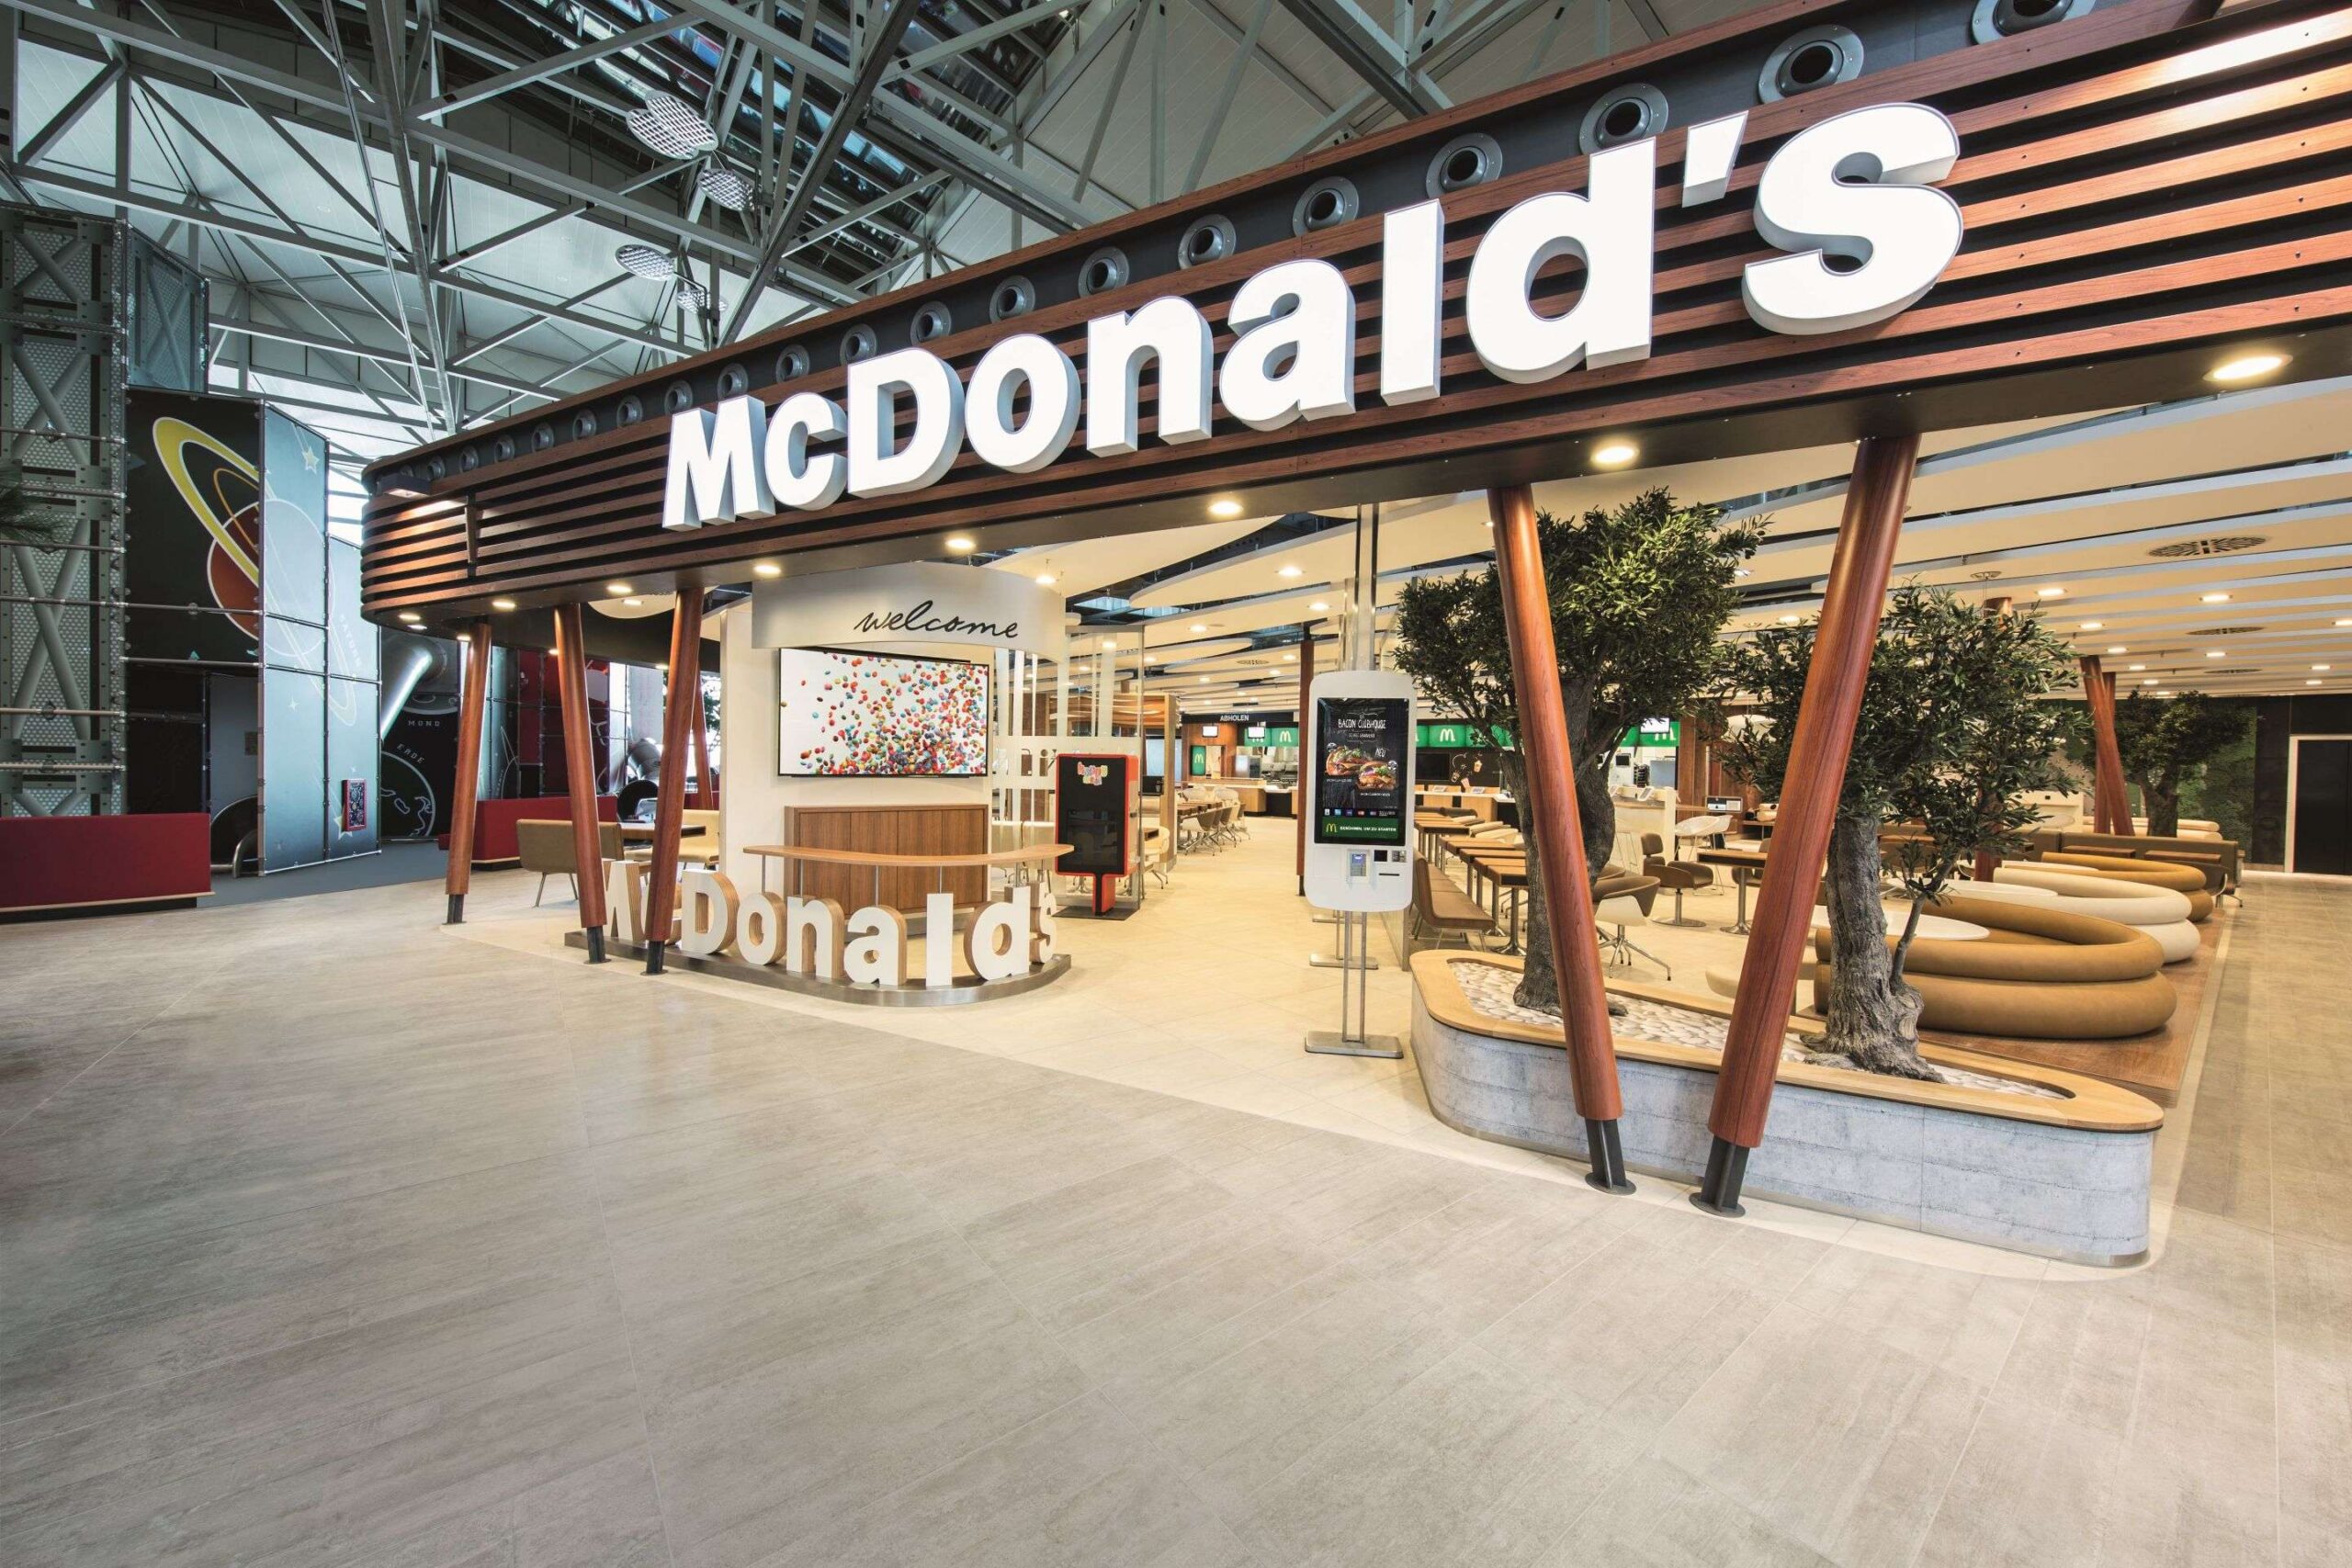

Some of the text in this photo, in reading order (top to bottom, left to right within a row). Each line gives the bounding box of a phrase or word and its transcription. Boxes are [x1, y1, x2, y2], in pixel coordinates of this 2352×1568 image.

[662, 103, 1964, 532] McDonald's
[853, 600, 1019, 638] welcome
[1338, 718, 1387, 729] BACON CLUBHOUSE
[396, 743, 425, 764] ERDE
